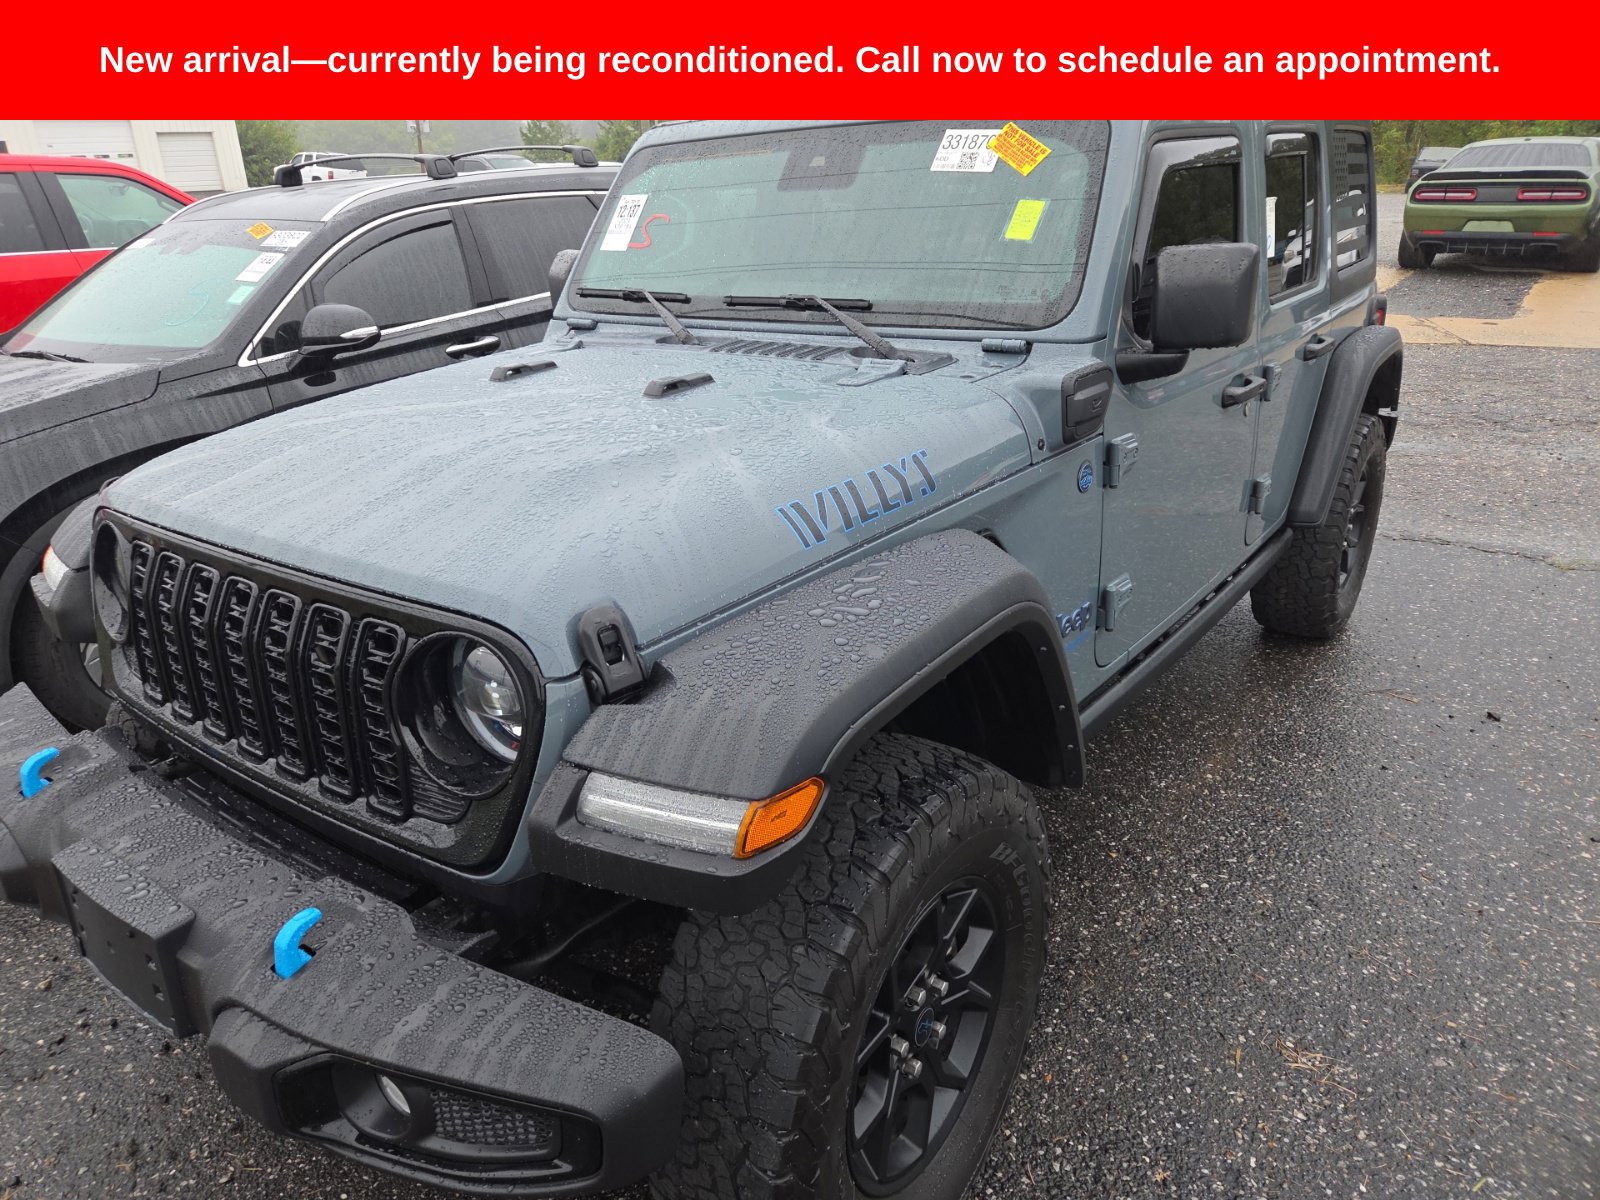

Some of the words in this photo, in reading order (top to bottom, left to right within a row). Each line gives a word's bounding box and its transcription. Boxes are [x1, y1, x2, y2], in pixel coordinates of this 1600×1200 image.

[1013, 137, 1026, 148] FOR
[1023, 145, 1040, 158] SALE
[1017, 132, 1041, 150] VEHICLE
[775, 449, 937, 549] WILLYS
